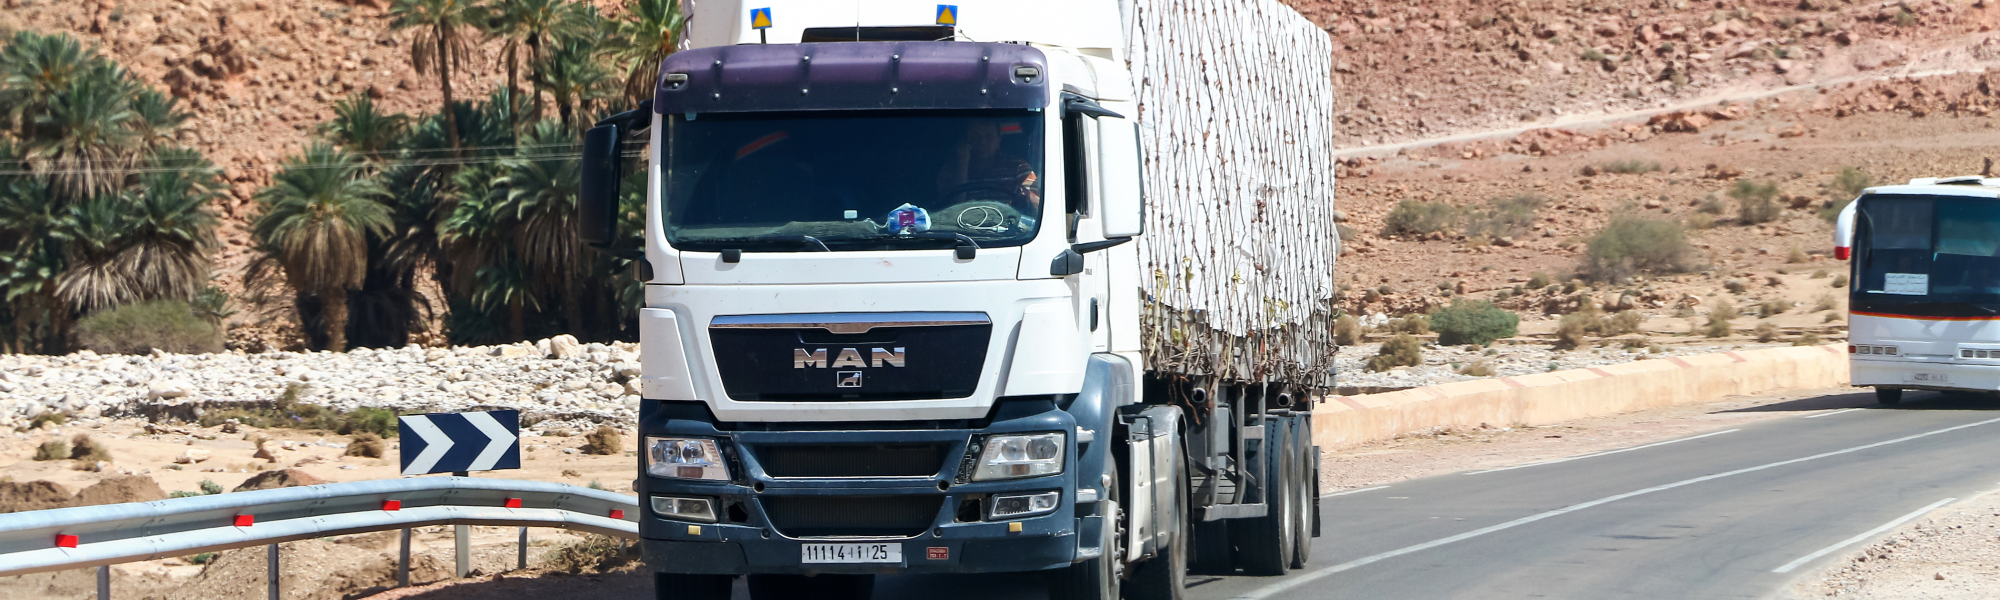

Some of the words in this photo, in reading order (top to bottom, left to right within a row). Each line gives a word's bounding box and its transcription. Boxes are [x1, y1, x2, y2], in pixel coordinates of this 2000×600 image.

[794, 347, 905, 368] MAN
[807, 545, 845, 560] 11114
[872, 545, 887, 560] 25
